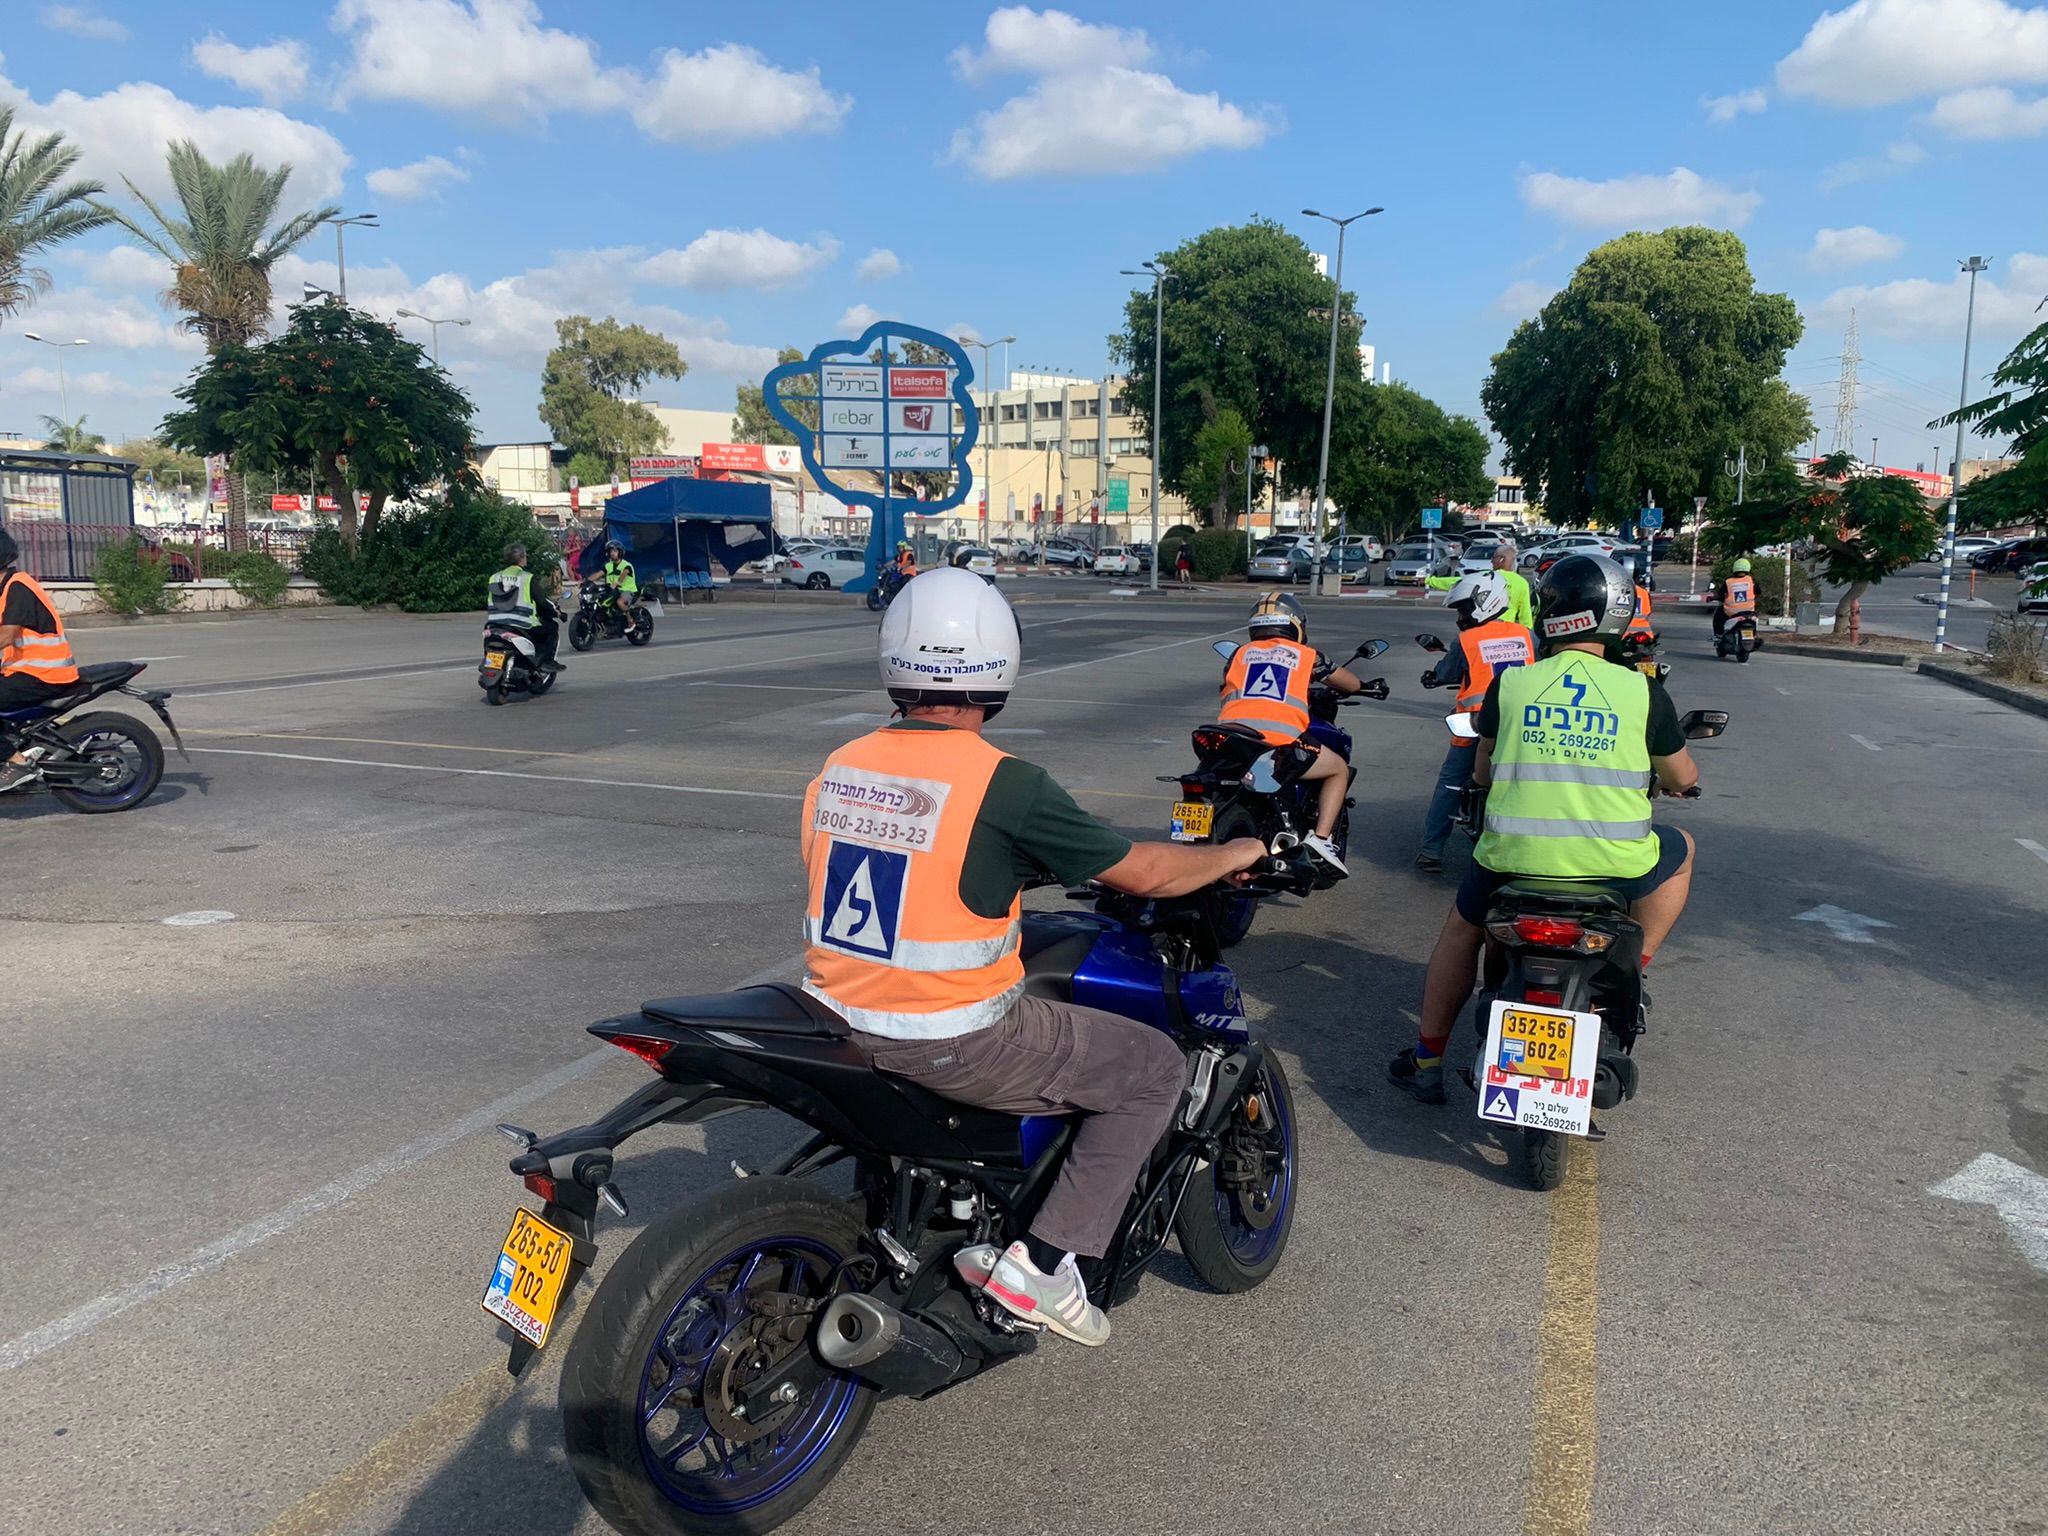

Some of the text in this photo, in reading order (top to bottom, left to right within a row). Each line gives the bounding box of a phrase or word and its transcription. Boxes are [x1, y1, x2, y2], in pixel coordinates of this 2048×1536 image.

[826, 377, 879, 392] ביתילי
[893, 376, 944, 386] Italsofa
[832, 409, 874, 425] rebar
[1547, 616, 1592, 634] נתיבים
[919, 645, 965, 654] LS2
[913, 663, 941, 674] 2005
[944, 664, 984, 674] תחבורה
[985, 658, 1007, 671] כרמל
[1261, 674, 1274, 692] ל
[1563, 674, 1587, 707] ל
[1523, 704, 1619, 736] נתיבים
[1522, 730, 1546, 744] 052
[1558, 733, 1616, 752] 2692261
[1537, 747, 1598, 761] שלום ניר
[821, 780, 905, 807] כרמל תחבורה
[815, 809, 928, 845] 1800-23-33-23
[1185, 819, 1202, 831] 802
[846, 881, 872, 937] ל
[1195, 1012, 1233, 1028] MT
[1527, 1041, 1558, 1060] 602
[1497, 1099, 1506, 1112] ל
[1533, 1101, 1569, 1114] שלום ניר
[1523, 1112, 1581, 1132] 052-2692261
[515, 1265, 544, 1306] 702
[503, 1299, 543, 1335] SUZUKA
